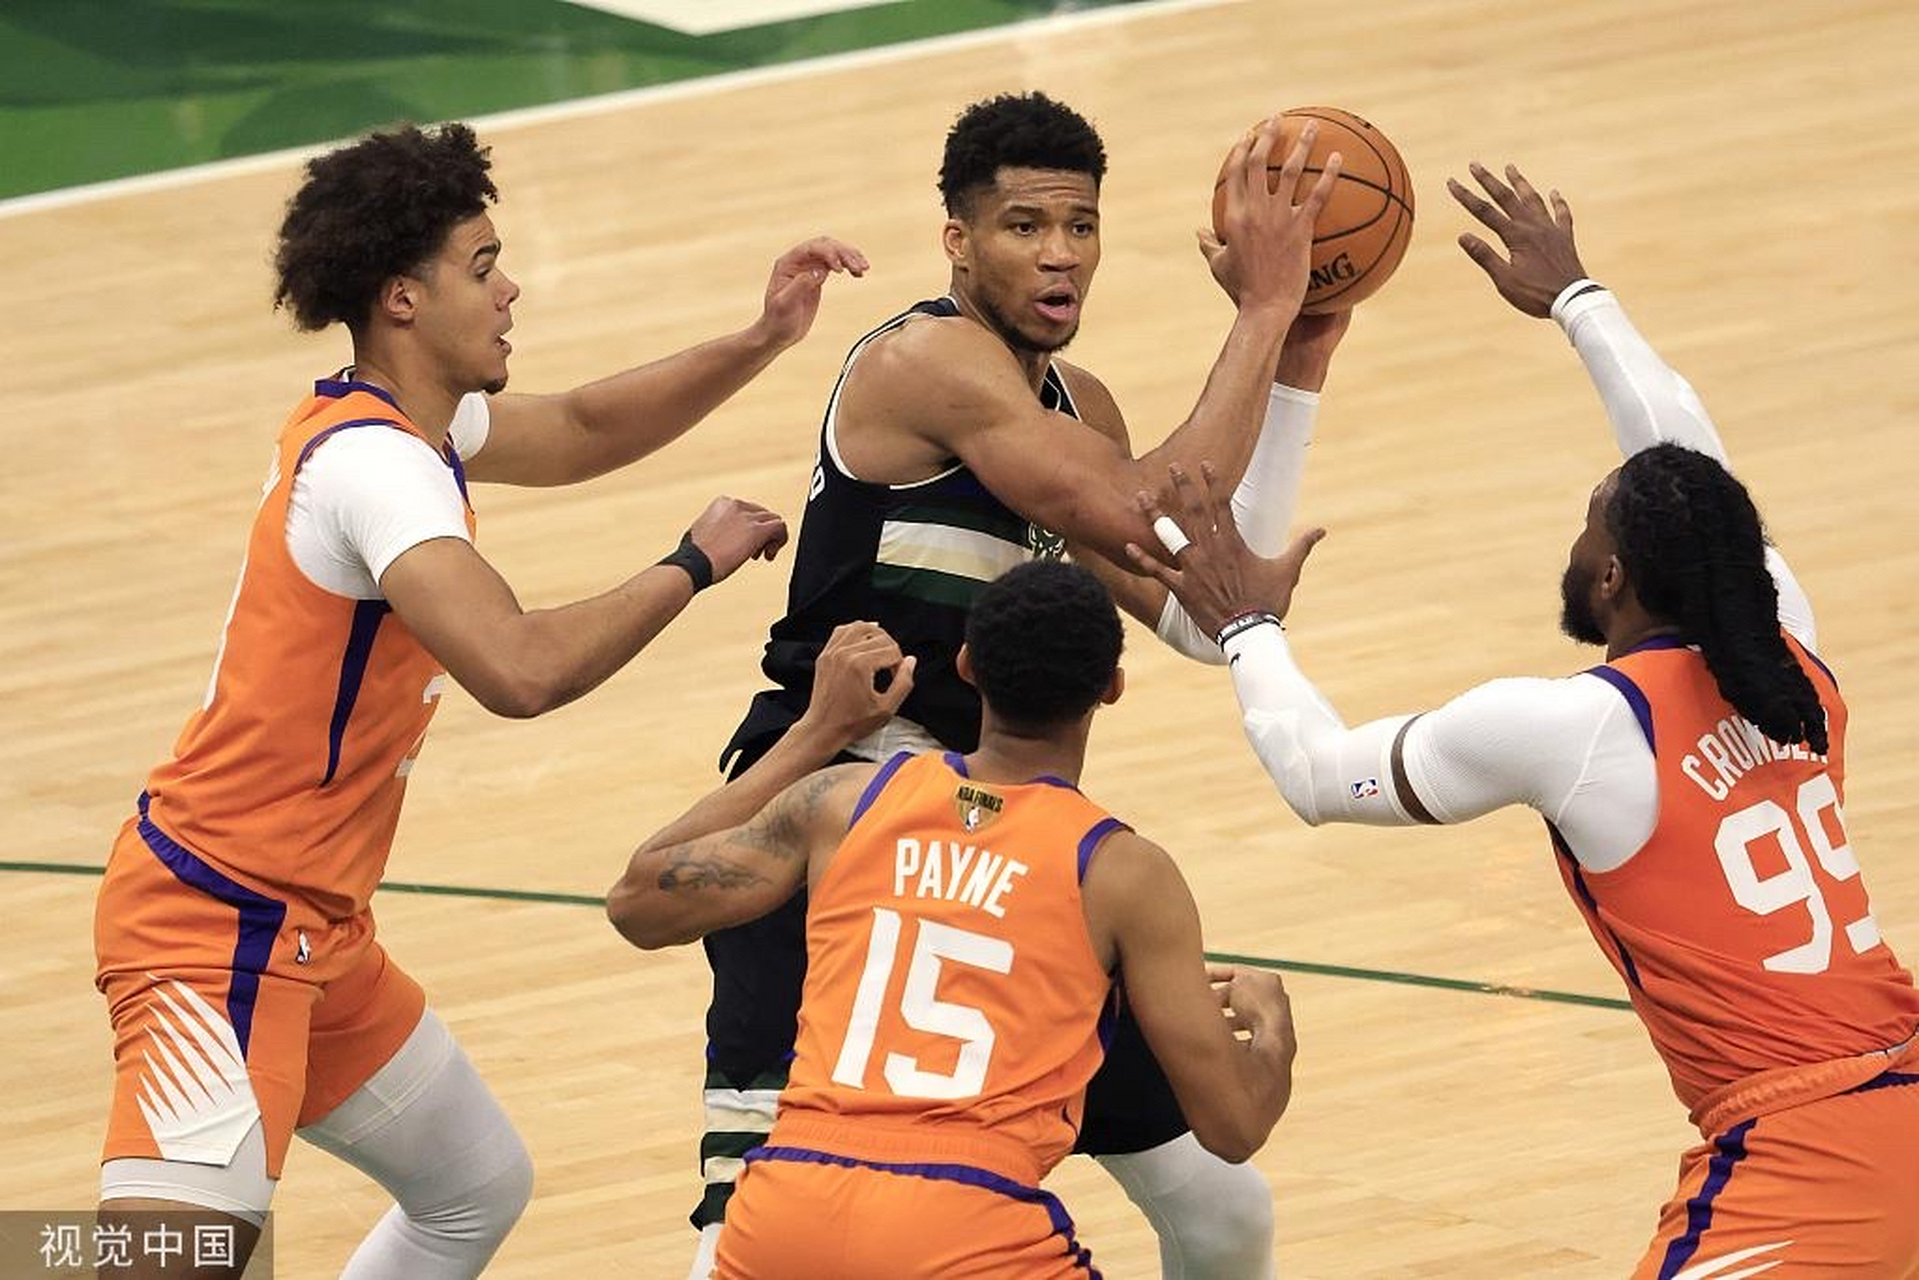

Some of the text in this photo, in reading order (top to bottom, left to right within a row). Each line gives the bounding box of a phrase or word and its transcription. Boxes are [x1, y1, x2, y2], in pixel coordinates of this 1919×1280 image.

[1309, 252, 1355, 290] NG
[1681, 707, 1828, 800] CROW
[895, 838, 1029, 917] PAYNE
[1714, 773, 1881, 974] 99
[831, 907, 1014, 1099] 15
